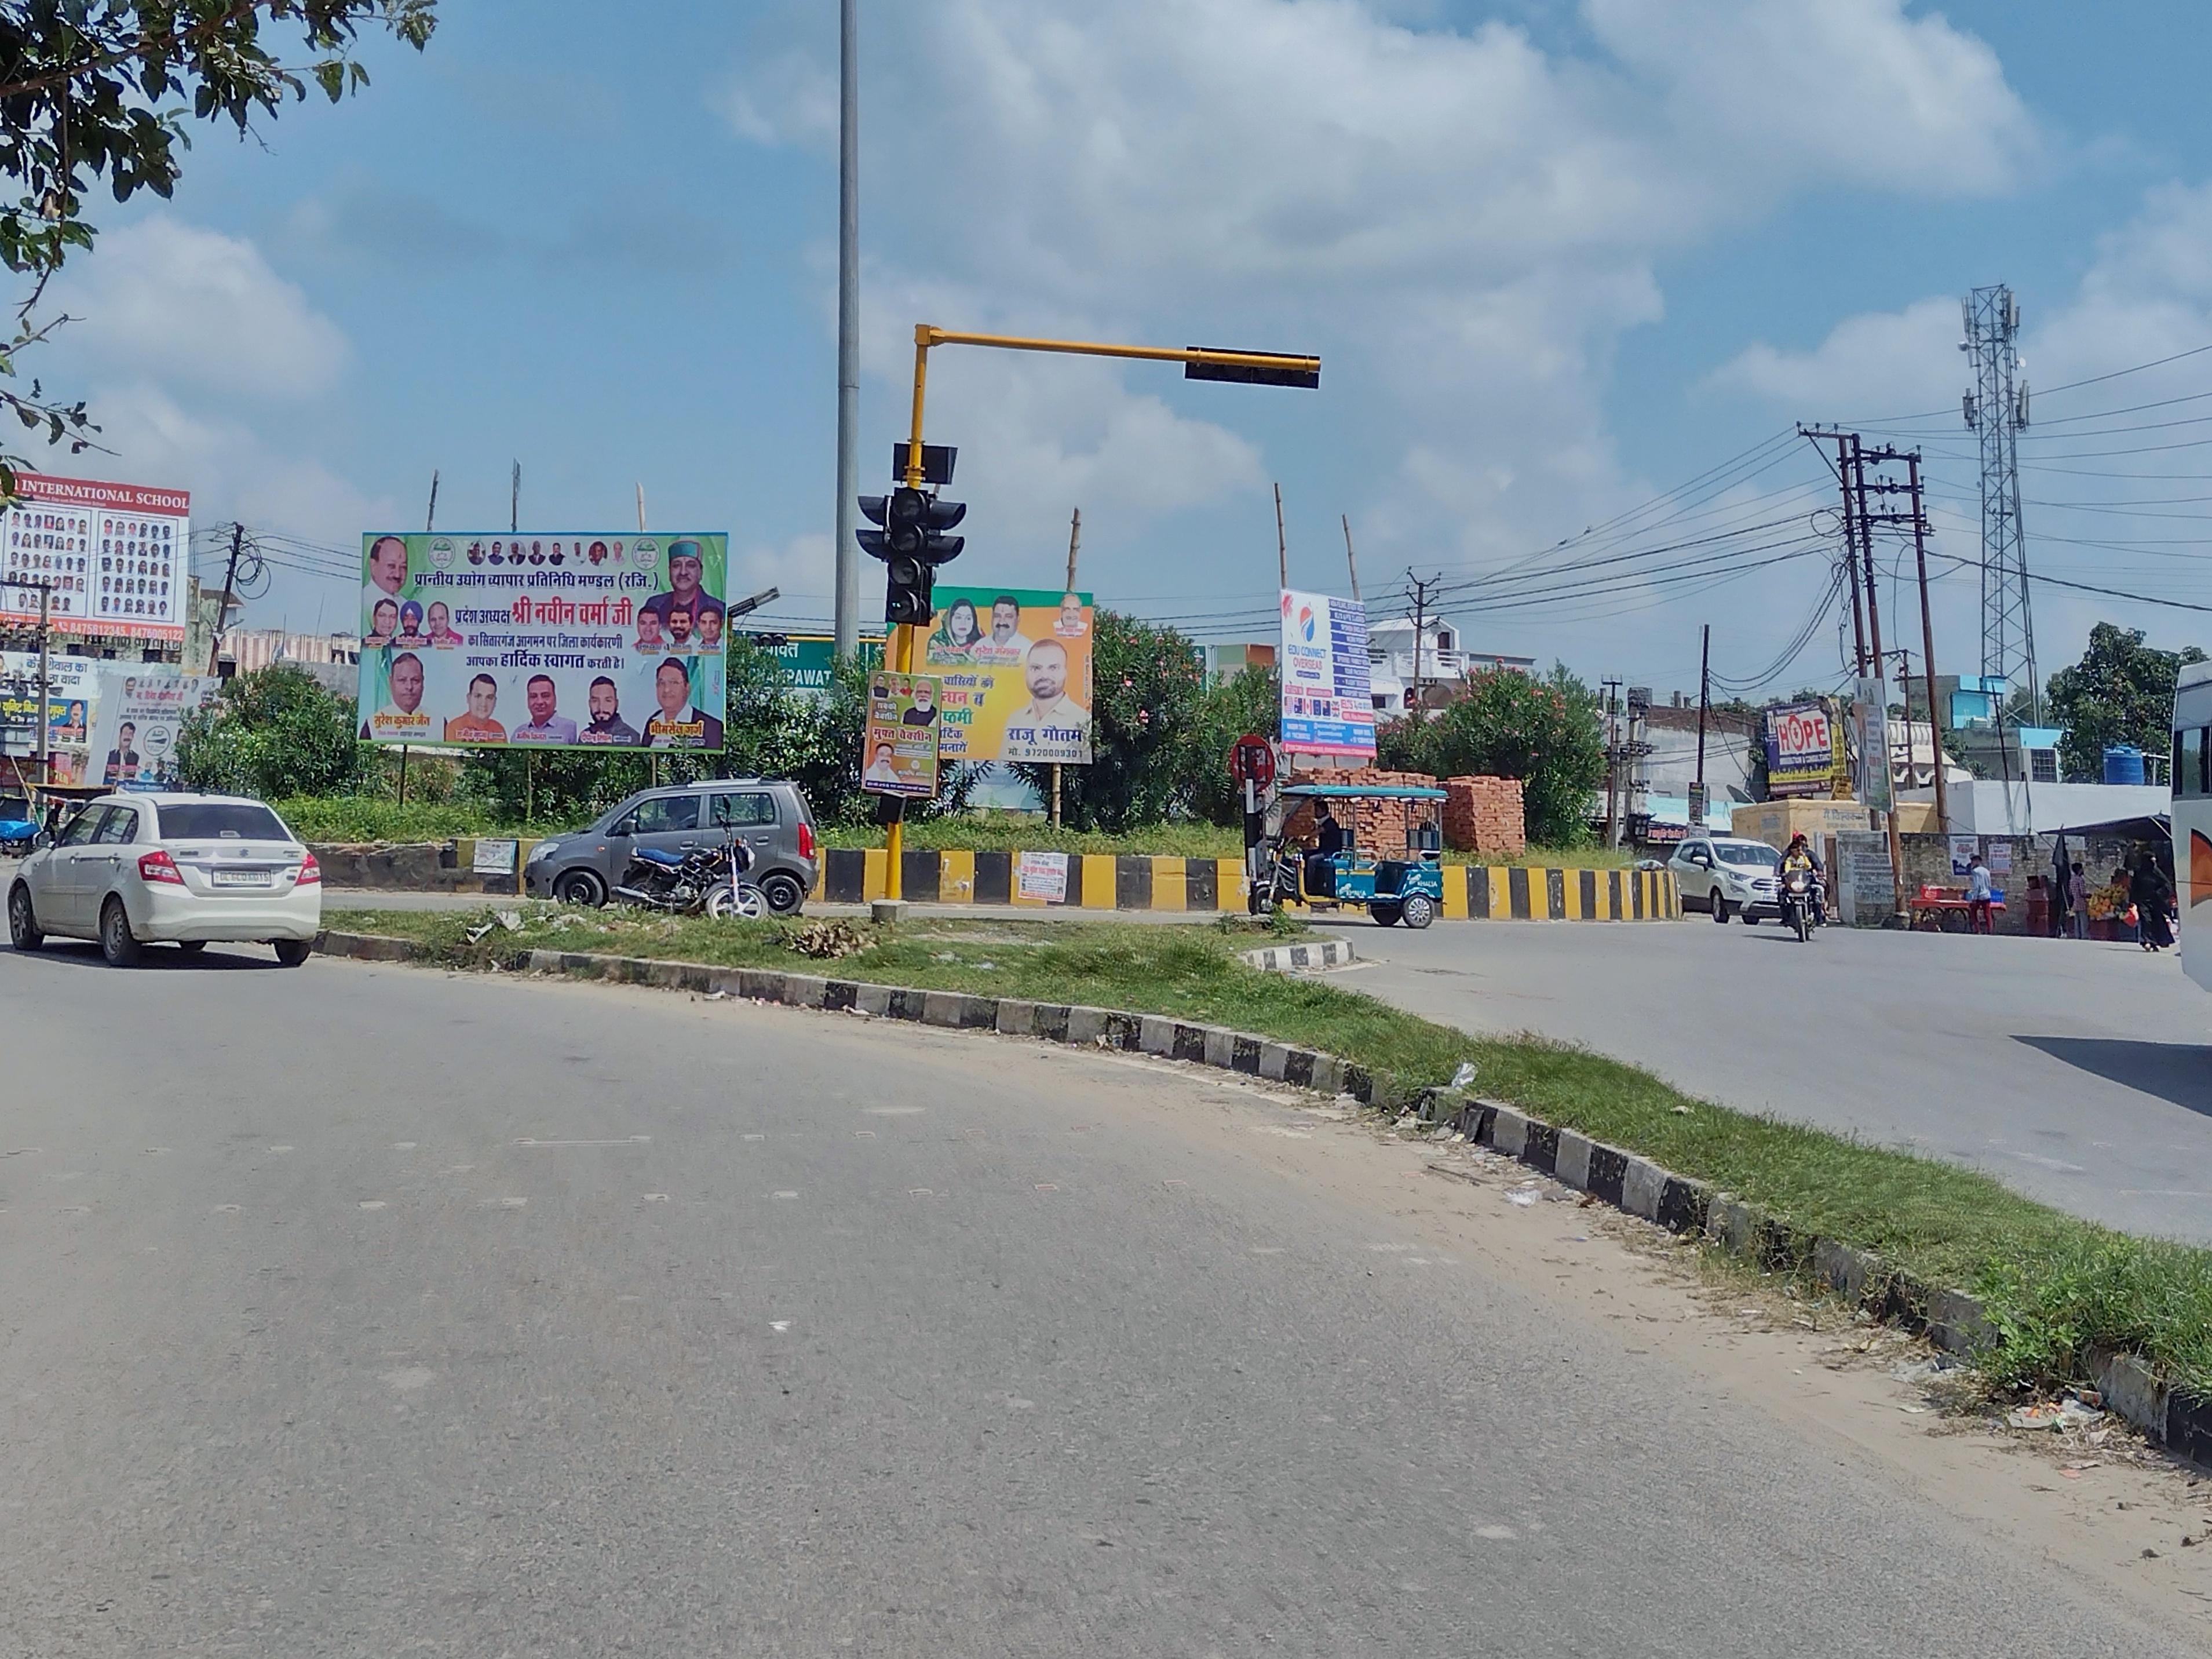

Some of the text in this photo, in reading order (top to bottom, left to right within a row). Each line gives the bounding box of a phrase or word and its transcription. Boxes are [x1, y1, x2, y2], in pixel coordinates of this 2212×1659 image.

[21, 479, 133, 502] INTERNATIONAL
[136, 493, 189, 509] SCHOOL
[488, 574, 523, 588] व्यापार
[527, 571, 575, 588] प्रतिनिधि
[578, 574, 614, 588] मण्डल
[455, 596, 633, 626] प्रदेश अध्यक्ष श्री नवीन वर्मा जी
[480, 631, 514, 647] सितारगंज
[516, 635, 545, 648] आगमन
[547, 635, 556, 648] पर
[558, 633, 578, 648] जिला
[466, 656, 498, 668] आपका
[501, 649, 542, 668] हार्दिक
[544, 654, 585, 668] स्वागत
[587, 656, 612, 669] करती
[1301, 646, 1327, 658] CONNECT
[1007, 724, 1082, 745] राजू गौतम
[1778, 714, 1827, 752] HOPE
